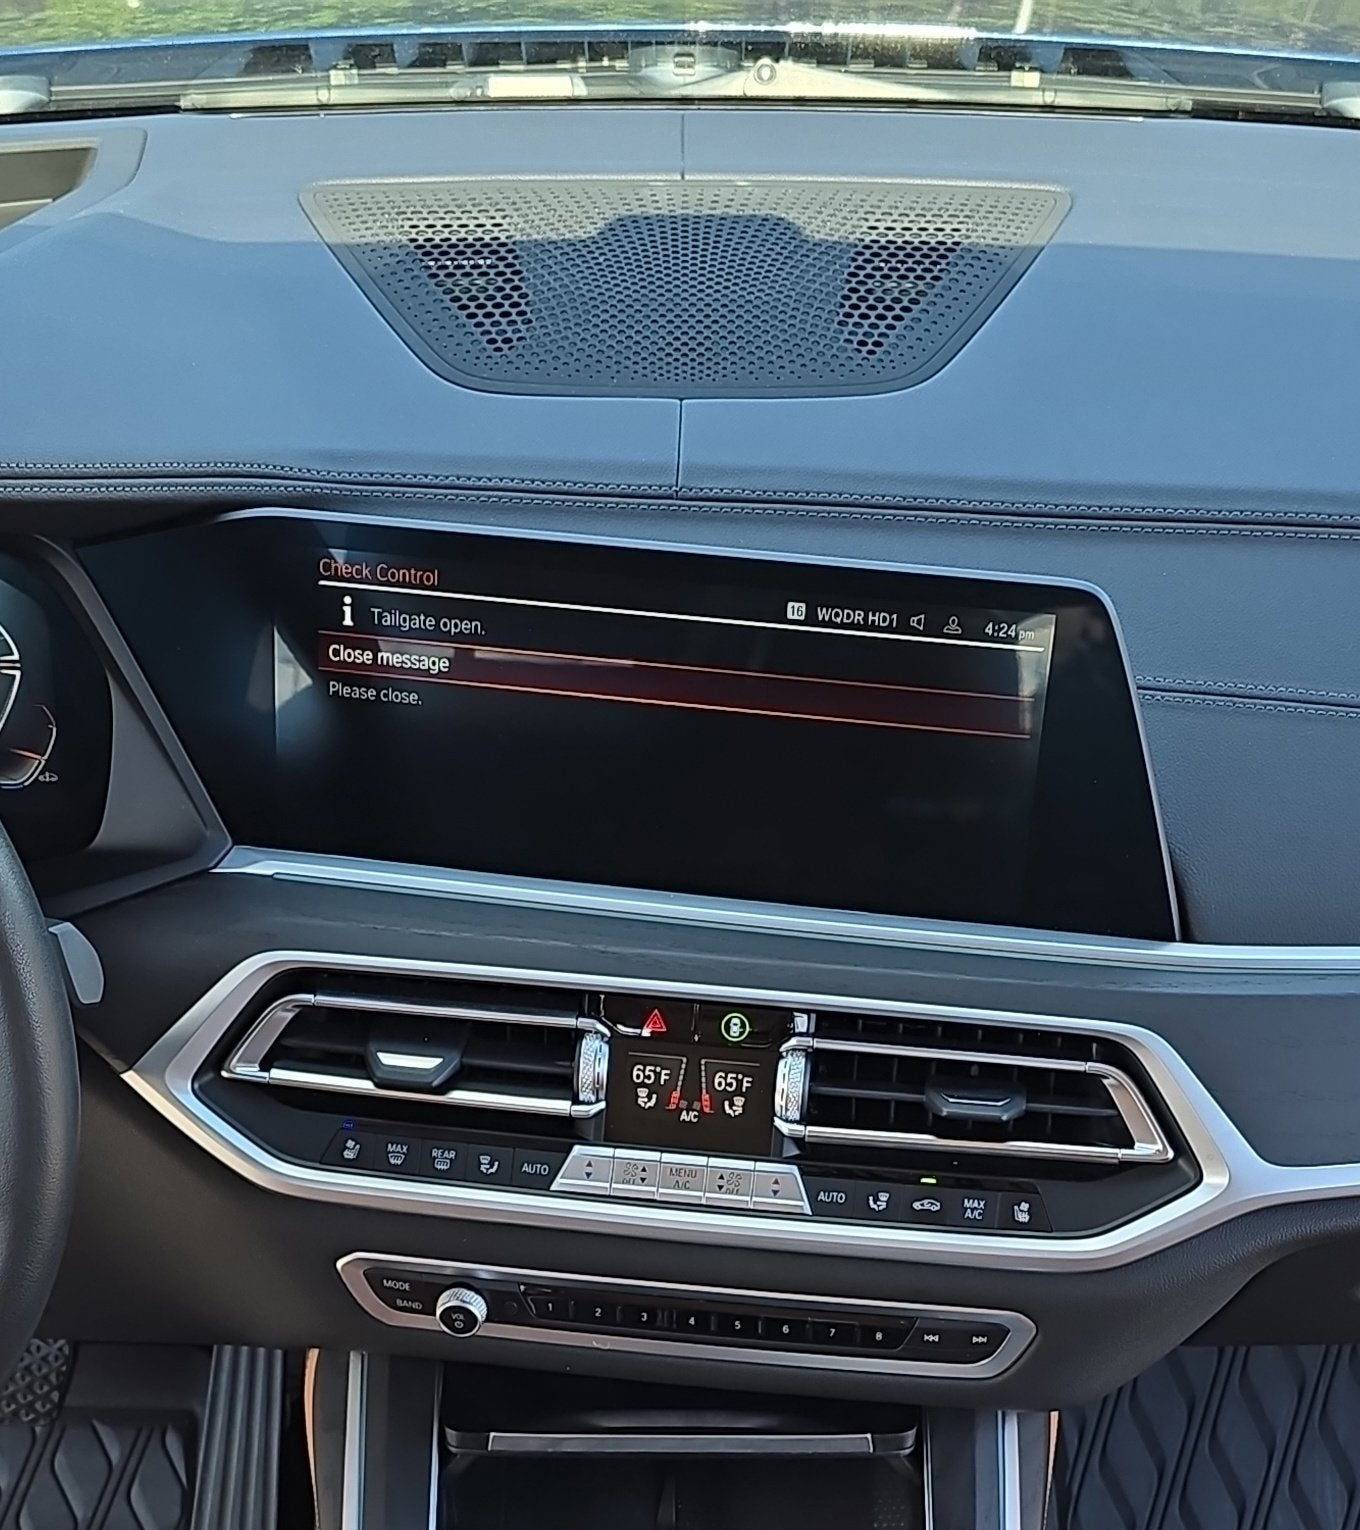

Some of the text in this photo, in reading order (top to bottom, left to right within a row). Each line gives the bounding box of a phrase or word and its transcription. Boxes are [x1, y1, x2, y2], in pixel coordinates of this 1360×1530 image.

[319, 558, 439, 586] Check Control
[370, 607, 436, 631] Tailgate
[440, 618, 486, 636] open.
[789, 603, 1035, 641] 16 WQDR HD1 4:24 pm
[328, 644, 450, 674] Close message
[329, 681, 422, 705] Please close.
[679, 1110, 699, 1123] A/C
[386, 1143, 408, 1154] MAX
[431, 1148, 456, 1160] REAR
[521, 1163, 549, 1176] AUTO
[669, 1167, 697, 1179] MENU
[673, 1180, 691, 1190] A/C
[817, 1191, 845, 1204] AUTO
[964, 1198, 986, 1210] MAX
[964, 1209, 983, 1220] A/C
[383, 1279, 411, 1292] MODE
[396, 1299, 422, 1311] BAND
[547, 1302, 553, 1311] 1
[451, 1313, 466, 1321] VOL
[595, 1307, 602, 1317] 2
[641, 1312, 647, 1321] 3
[688, 1317, 695, 1326] 4
[734, 1320, 741, 1330] 5
[782, 1324, 789, 1334] 6
[829, 1328, 836, 1337] 7
[875, 1332, 883, 1341] 8
